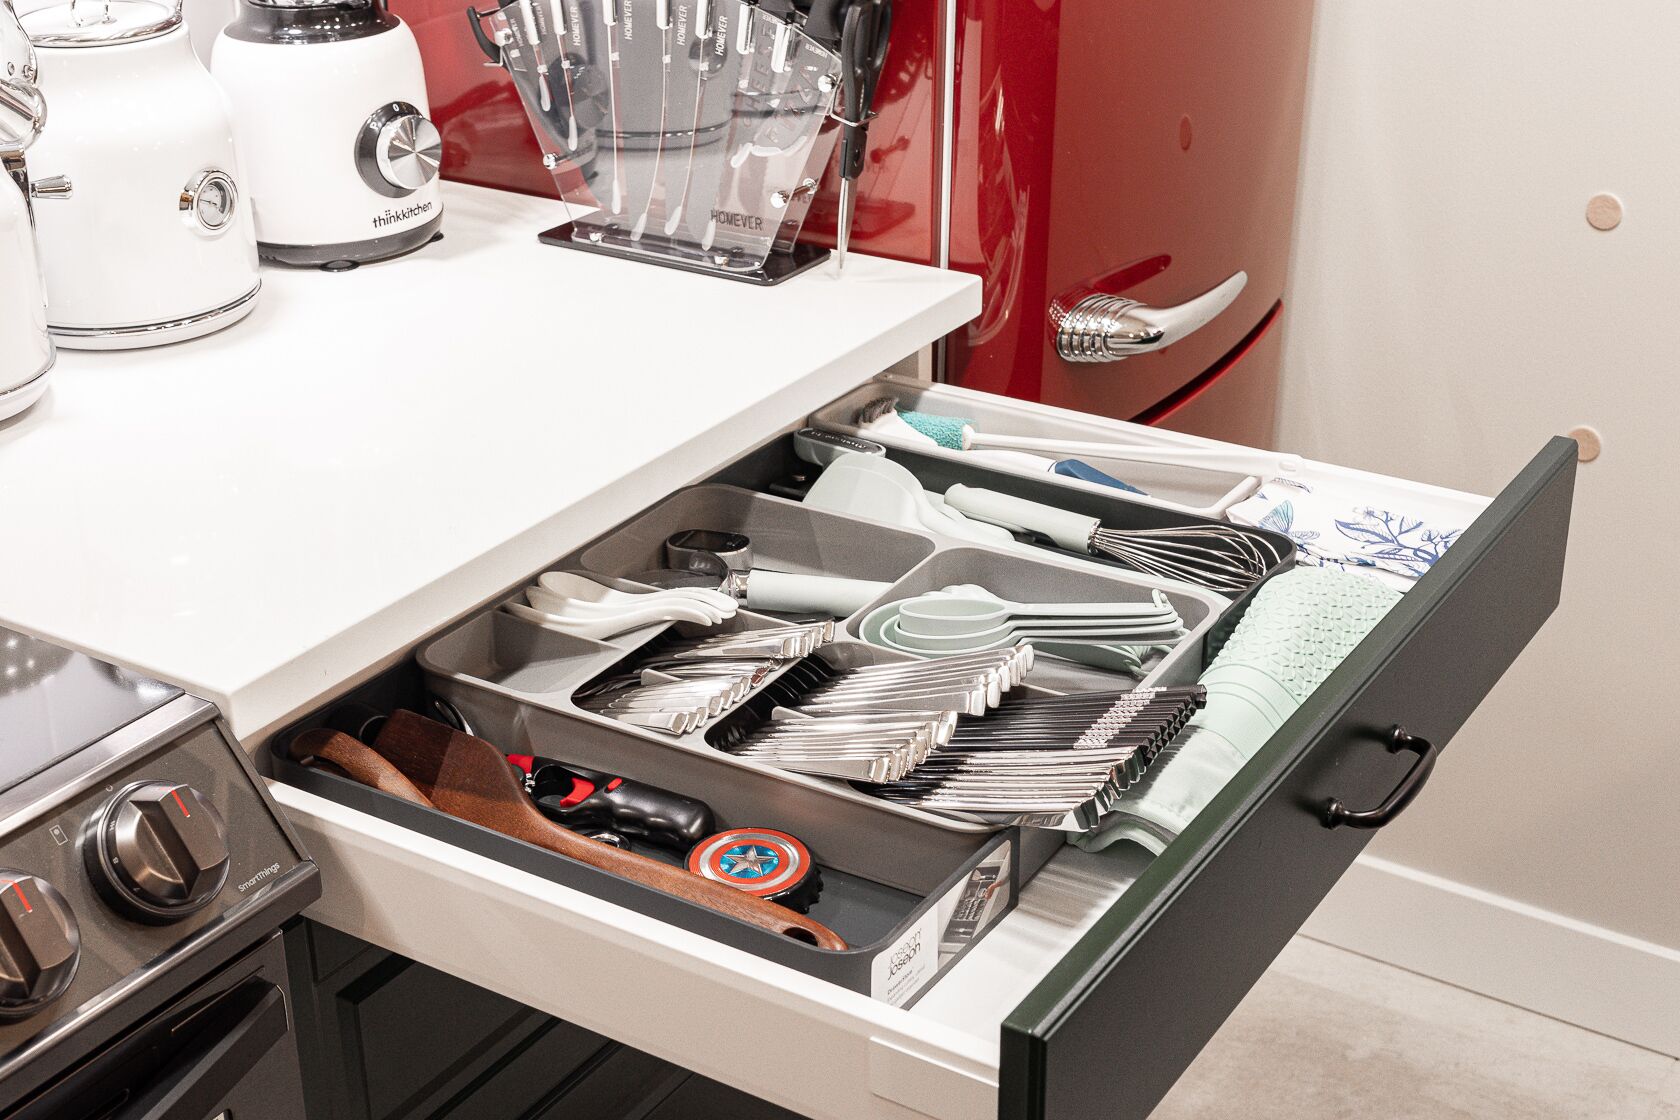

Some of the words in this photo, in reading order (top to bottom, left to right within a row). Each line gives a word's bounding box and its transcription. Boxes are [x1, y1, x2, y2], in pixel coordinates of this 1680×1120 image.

[570, 6, 581, 46] HOMEVER
[623, 0, 633, 41] HOMEVER
[676, 5, 688, 46] HOMEVER
[714, 15, 729, 56] HOMEVER
[711, 209, 764, 231] HOMEVER
[238, 862, 281, 893] SmartThings
